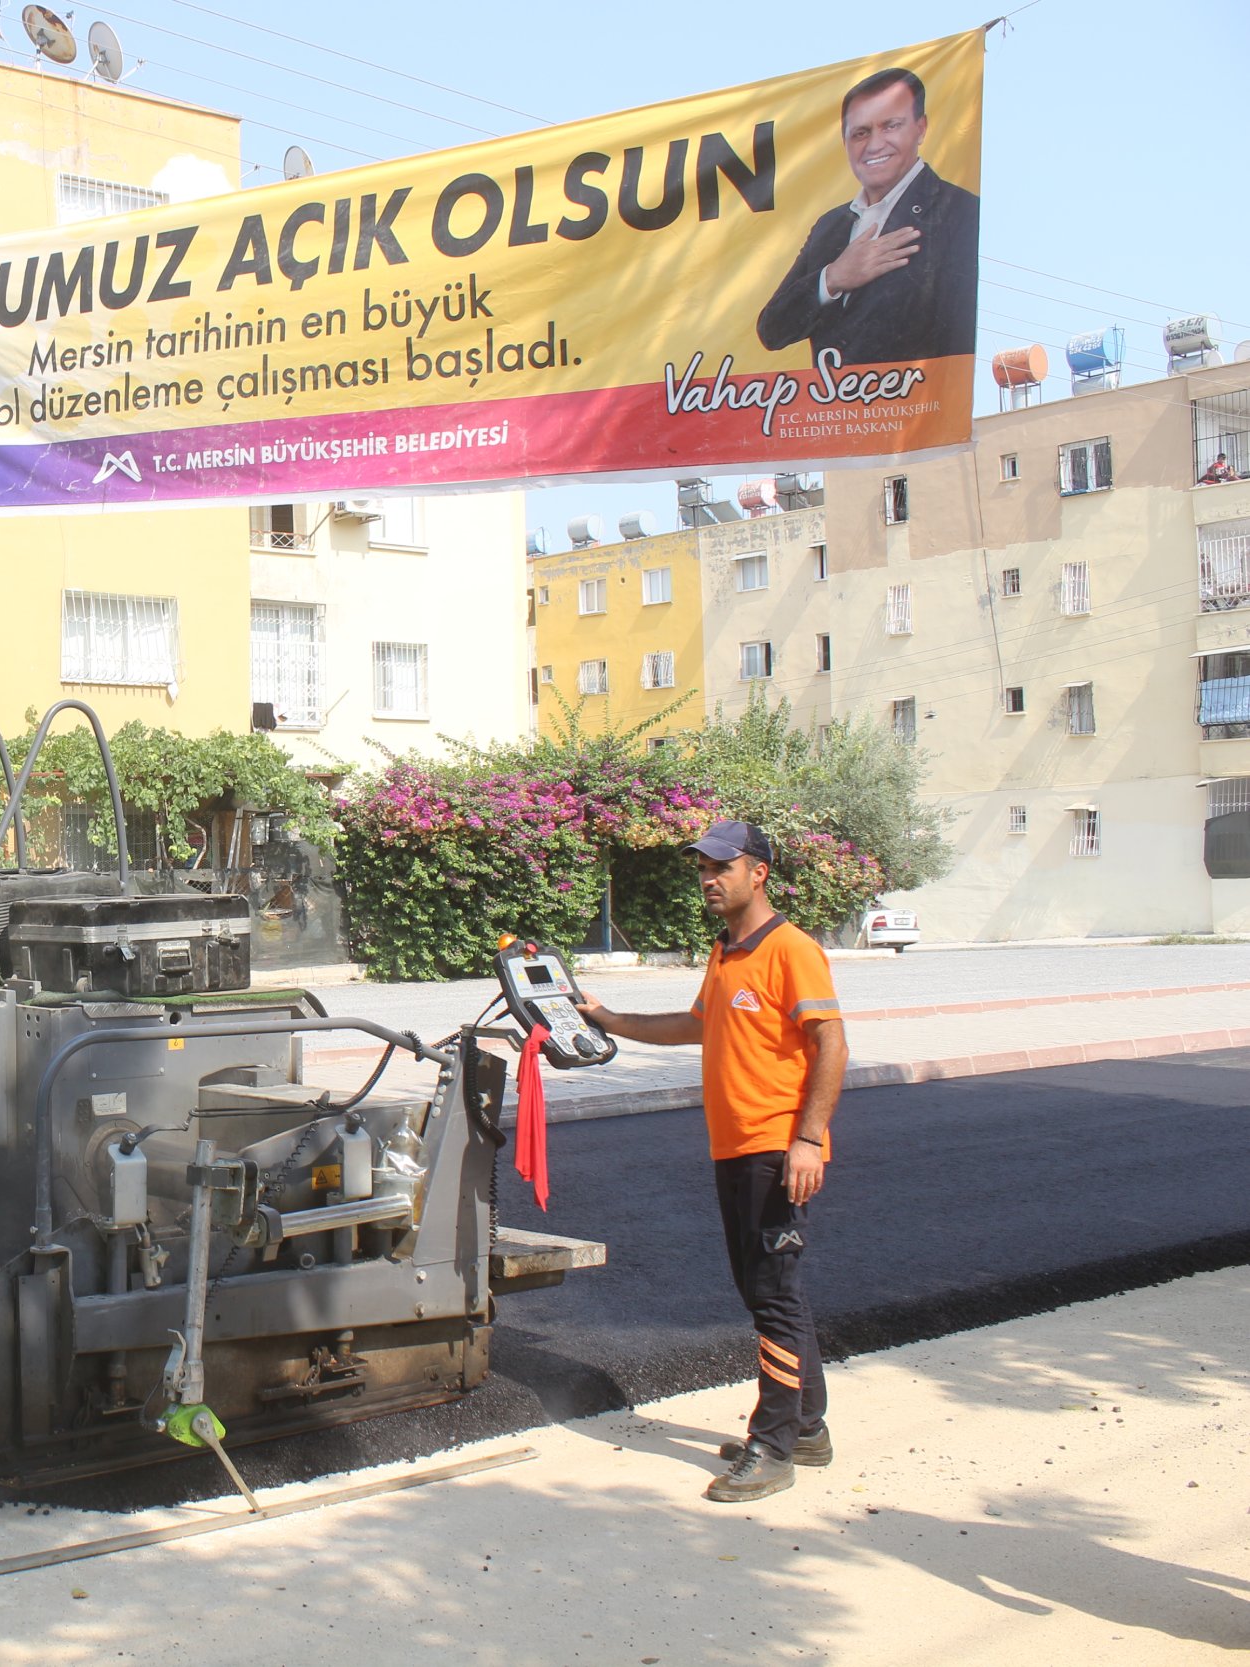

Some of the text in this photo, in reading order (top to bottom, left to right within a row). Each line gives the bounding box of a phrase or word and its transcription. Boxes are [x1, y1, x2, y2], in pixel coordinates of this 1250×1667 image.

[216, 187, 413, 291] AÇIK
[432, 120, 775, 258] OLSUN
[28, 273, 493, 376] Mersin tarihinin en büyük
[30, 372, 203, 423] düzenleme
[217, 353, 389, 412] çalışması
[406, 321, 582, 388] başladı.
[664, 347, 925, 437] Vahap Seçer
[779, 400, 940, 425] T.C. MERSİN BÜYÜKŞEHİR
[153, 420, 509, 473] T.C. MERSİN BÜYÜKŞEHİR BELEDİYESİ
[780, 421, 903, 438] BELEDİYE BAŞKANI
